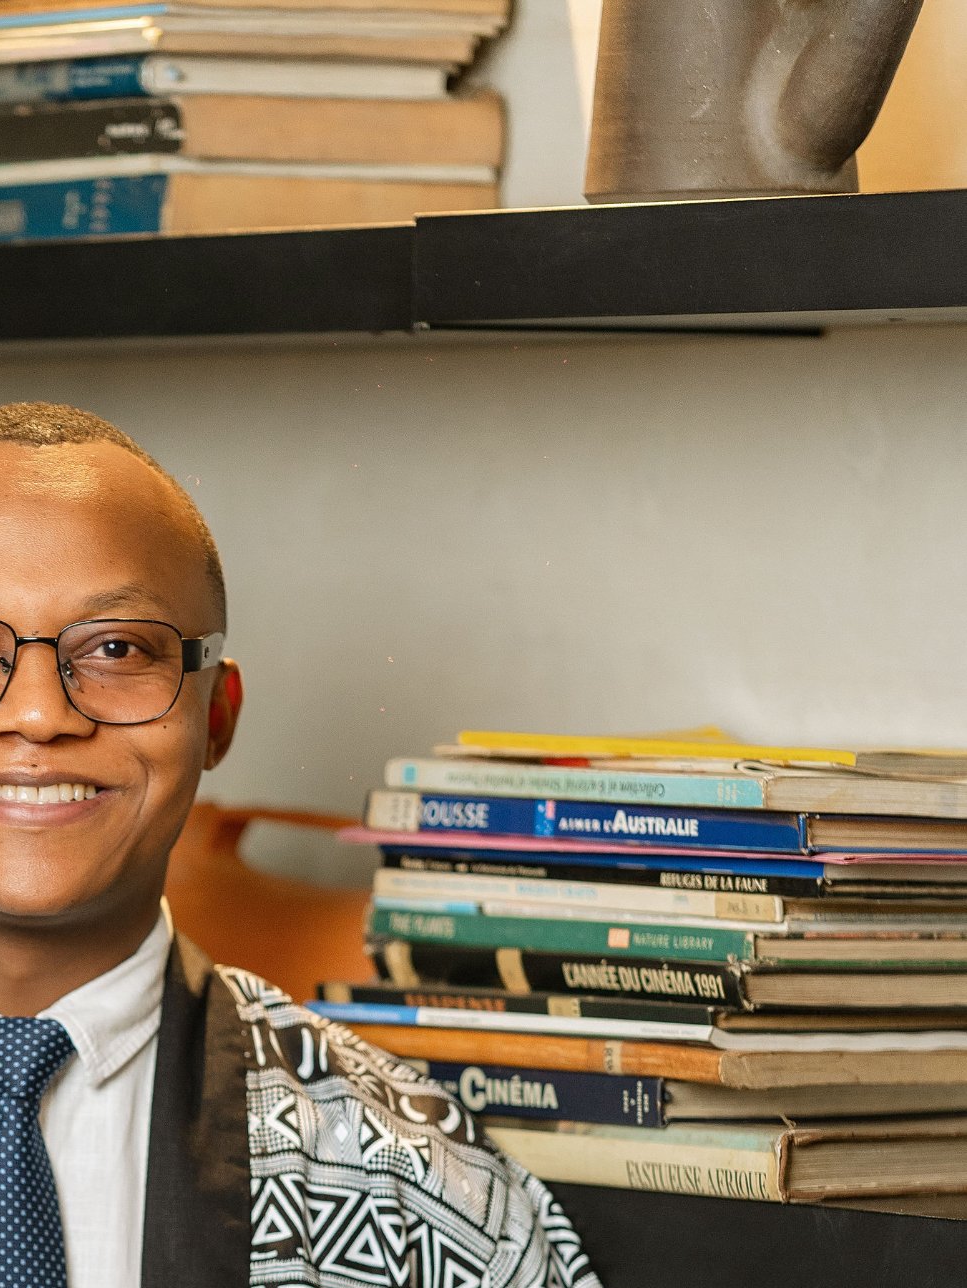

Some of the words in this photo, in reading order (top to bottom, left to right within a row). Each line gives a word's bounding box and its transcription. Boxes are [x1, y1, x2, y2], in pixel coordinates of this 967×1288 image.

[660, 872, 702, 890] REFUGES
[703, 876, 719, 890] DE
[720, 877, 734, 891] LA
[735, 877, 769, 893] FAUNE
[634, 933, 669, 949] NATURE
[673, 936, 714, 950] LIBRARY
[562, 959, 620, 990] L'ANNÉE
[618, 967, 642, 993] DU
[640, 963, 697, 997] CINÉMA
[694, 972, 726, 999] 1991
[459, 1066, 559, 1112] CINÉMA
[626, 1160, 704, 1193] FASTUEUSE
[707, 1168, 770, 1200] AFRIQUE
